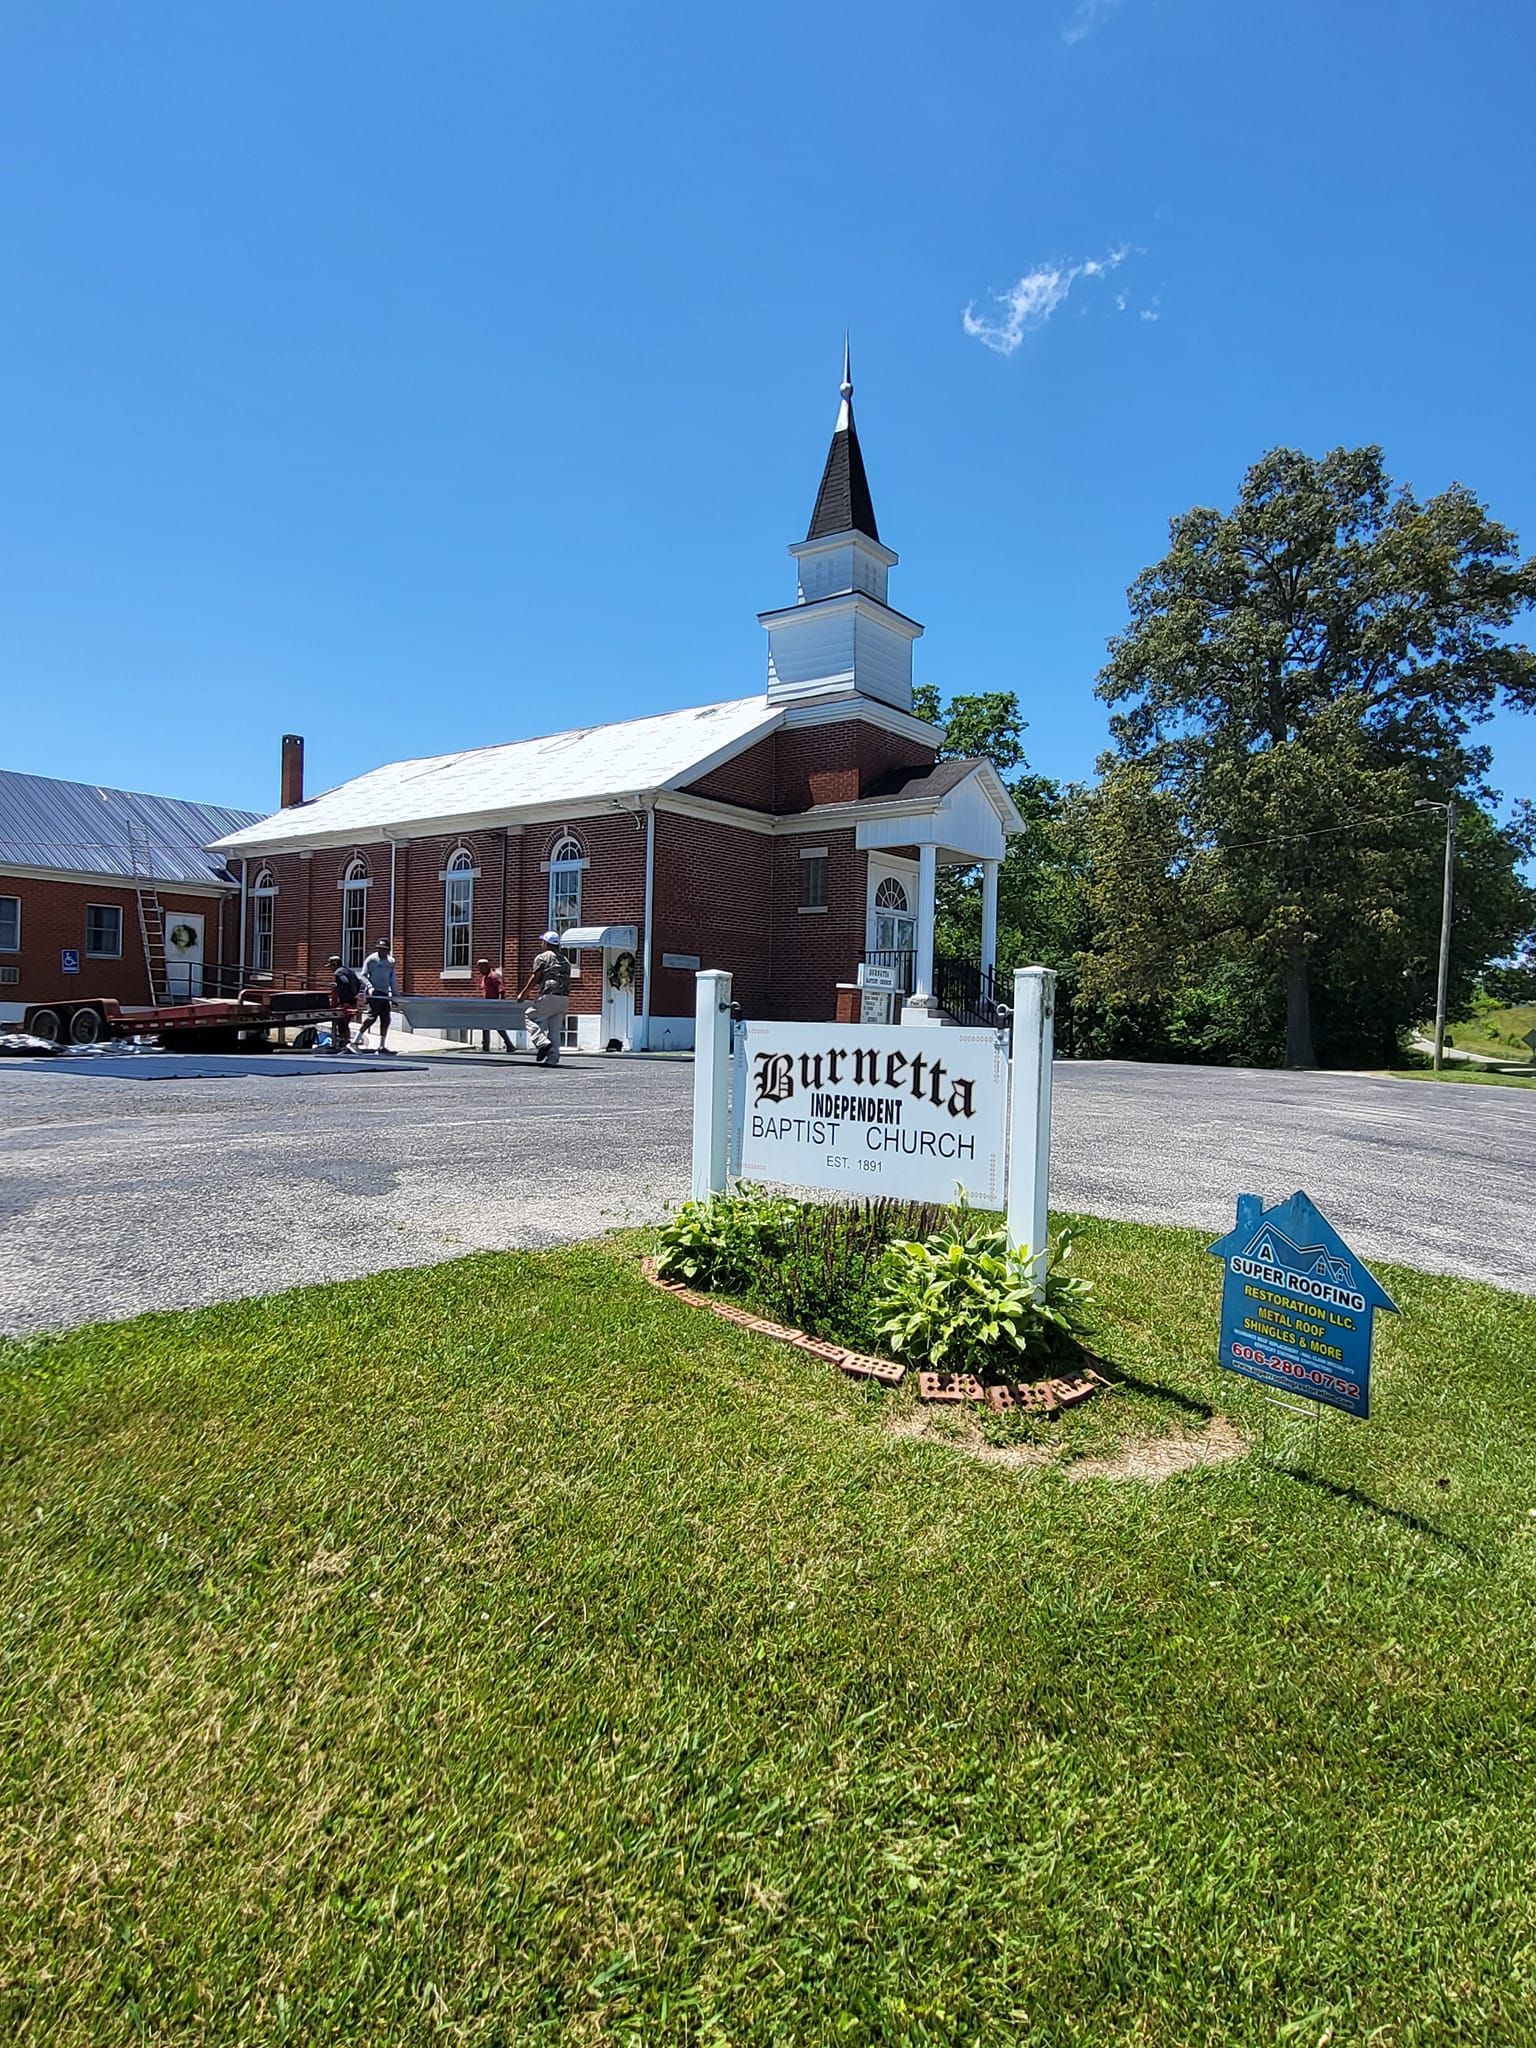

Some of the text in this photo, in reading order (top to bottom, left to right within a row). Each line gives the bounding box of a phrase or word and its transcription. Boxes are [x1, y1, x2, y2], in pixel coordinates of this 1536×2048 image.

[753, 1048, 976, 1119] Burnetta
[811, 1093, 903, 1125] INDEPENDENT
[752, 1115, 975, 1160] BAPTIST CHURCH
[826, 1155, 883, 1173] EST. 1891
[1259, 1244, 1273, 1262] A
[1232, 1257, 1364, 1311] SUPER ROOFING
[1244, 1285, 1356, 1330] RESTORATION LLC.
[1258, 1307, 1326, 1337] METAL ROOF
[1243, 1318, 1296, 1344] SHINGLES
[1299, 1337, 1307, 1348] &
[1310, 1340, 1343, 1360] MORE
[1232, 1343, 1360, 1399] 606-280-0752
